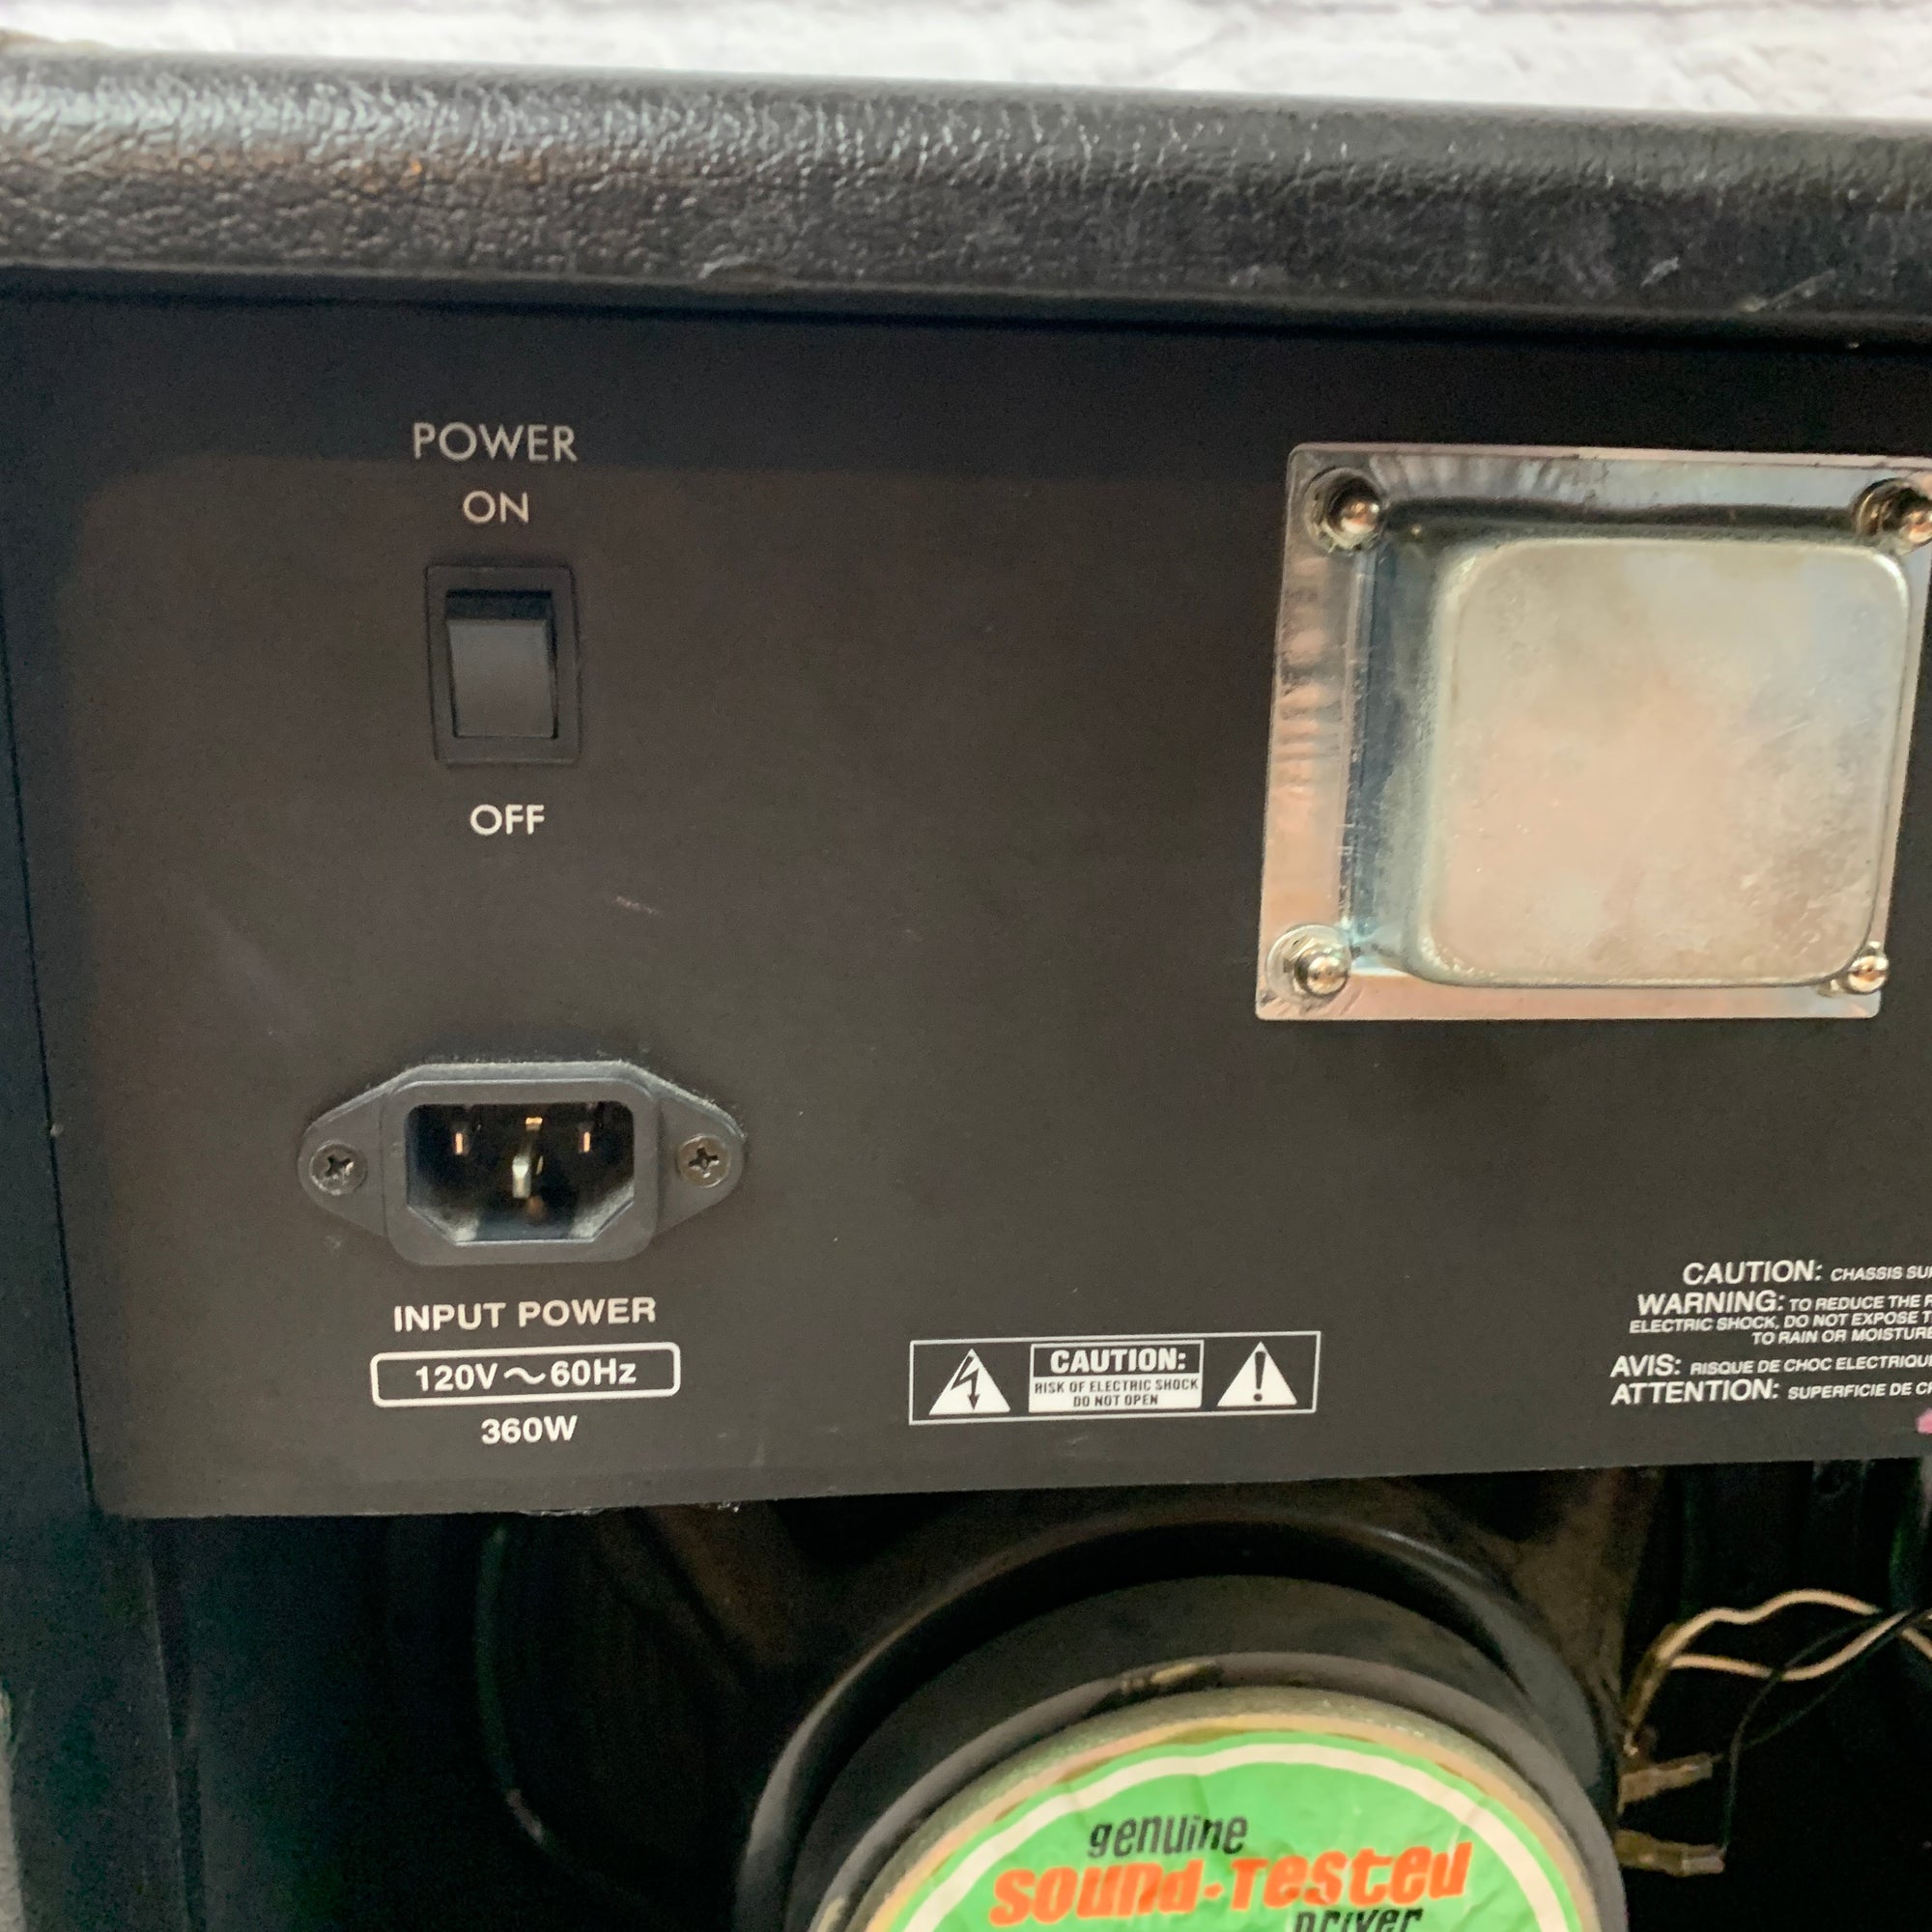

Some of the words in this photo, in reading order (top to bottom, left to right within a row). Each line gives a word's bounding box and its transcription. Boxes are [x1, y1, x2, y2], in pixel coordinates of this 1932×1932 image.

[412, 422, 578, 463] POWER
[462, 490, 530, 524] ON
[469, 804, 546, 836] OFF
[1683, 1260, 1824, 1286] CAUTION:
[1830, 1265, 1903, 1282] CHASSIS
[392, 1301, 507, 1333] INPUT
[518, 1296, 657, 1328] POWER
[1636, 1290, 1786, 1316] WARNING:
[1789, 1297, 1812, 1312] TO
[1815, 1295, 1885, 1311] REDUCE
[1888, 1294, 1921, 1309] THE
[1629, 1318, 1714, 1334] ELECTRIC
[1783, 1314, 1810, 1329] DO
[1812, 1313, 1849, 1328] NOT
[1851, 1311, 1919, 1326] EXPOSE
[1751, 1330, 1776, 1346] TO
[1777, 1329, 1819, 1345] RAIN
[1821, 1328, 1848, 1344] OR
[1049, 1348, 1187, 1374] CAUTION:
[1609, 1353, 1682, 1378] AVIS:
[1690, 1360, 1754, 1376] RISQUE
[1757, 1358, 1781, 1374] DE
[1783, 1357, 1833, 1373] CHOC
[1034, 1381, 1065, 1395] RISK
[1069, 1380, 1086, 1393] OF
[1089, 1379, 1151, 1393] ELECTRIC
[1154, 1378, 1199, 1391] SHOCK
[1610, 1378, 1779, 1406] ATTENTION:
[1787, 1383, 1887, 1401] SUPERFICIE
[1889, 1381, 1913, 1397] DE
[1073, 1395, 1090, 1407] DO
[1094, 1394, 1121, 1406] NOT
[1124, 1394, 1158, 1406] OPEN
[480, 1414, 579, 1444] 360W
[1088, 1813, 1248, 1859] genuine
